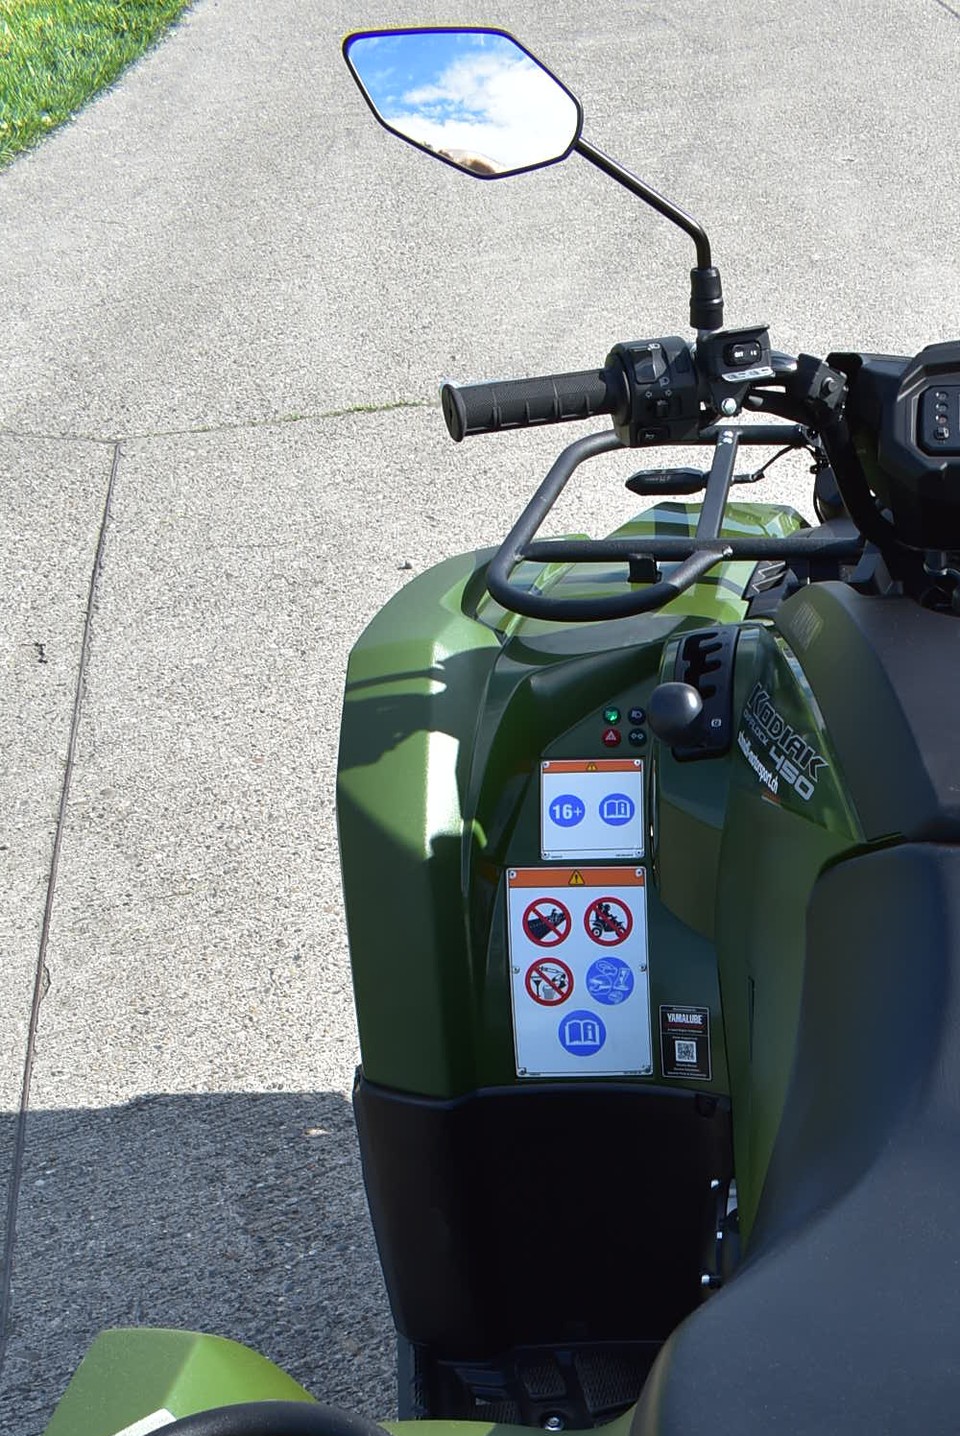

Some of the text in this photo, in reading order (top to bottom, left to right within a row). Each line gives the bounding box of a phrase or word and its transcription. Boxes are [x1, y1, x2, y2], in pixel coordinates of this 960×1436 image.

[747, 682, 829, 782] KODIAK
[769, 745, 815, 800] 450
[552, 803, 582, 820] 16+
[667, 1013, 703, 1025] YAMALUBE
